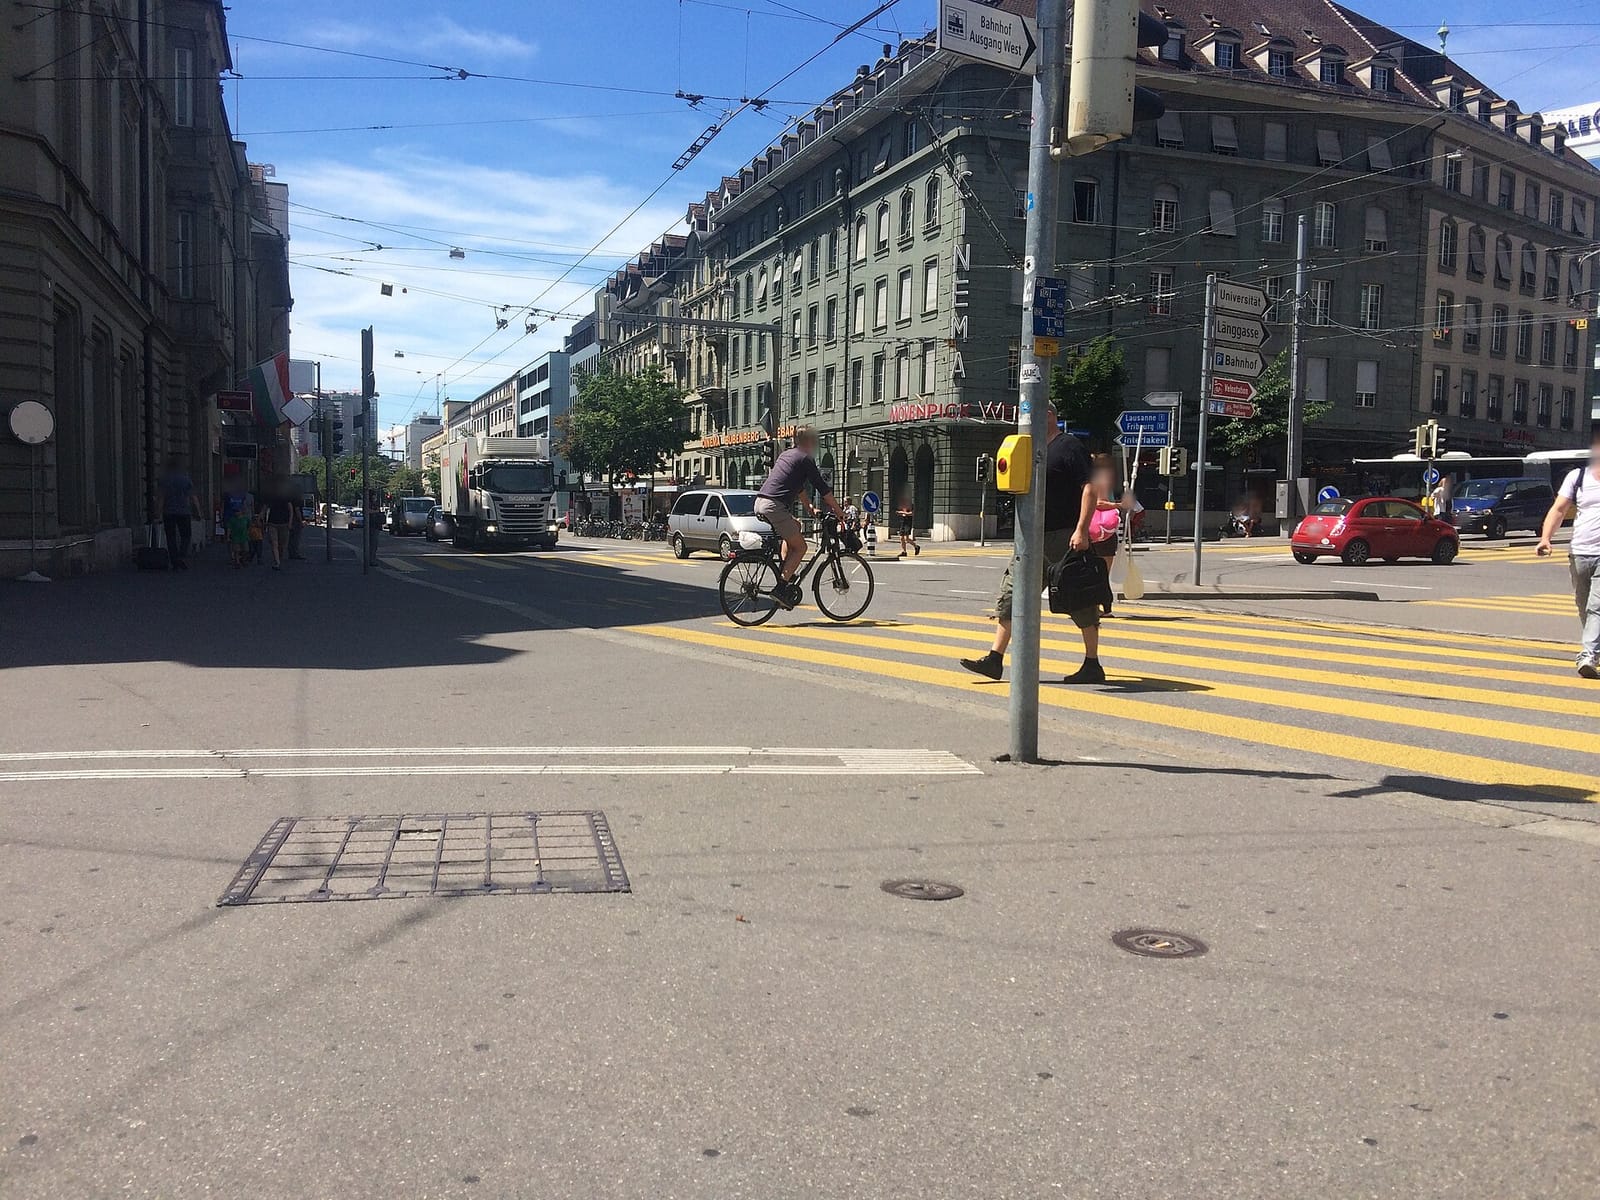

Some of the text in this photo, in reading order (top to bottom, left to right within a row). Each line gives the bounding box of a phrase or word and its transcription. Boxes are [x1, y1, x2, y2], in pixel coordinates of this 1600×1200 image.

[980, 15, 1012, 36] Bahnhof
[969, 30, 1022, 56] Ausgang West
[951, 170, 973, 379] CINEMA
[1220, 289, 1261, 307] Universität
[1217, 320, 1259, 339] Länggasse
[1225, 355, 1258, 370] Bahnhof
[1125, 414, 1157, 422] Lausanne
